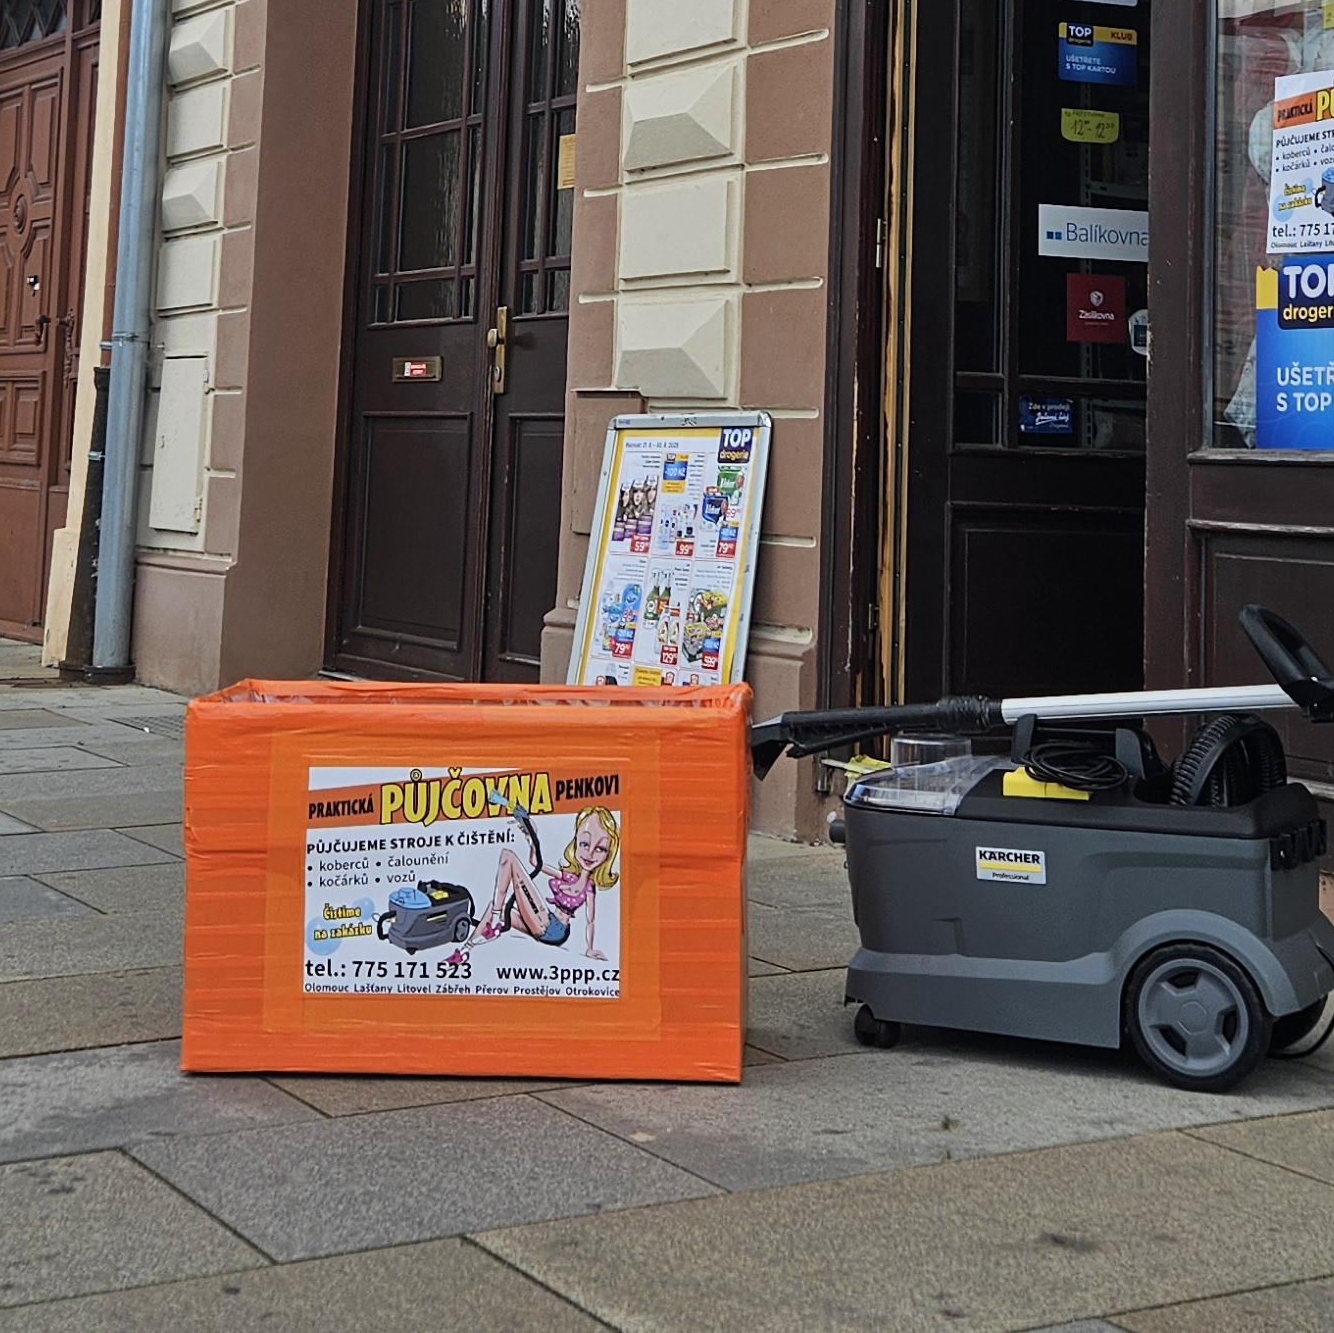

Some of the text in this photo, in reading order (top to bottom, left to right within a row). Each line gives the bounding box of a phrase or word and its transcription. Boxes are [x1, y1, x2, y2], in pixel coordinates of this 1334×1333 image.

[1068, 25, 1092, 37] TOP
[1275, 132, 1321, 148] PŮJČUJEME
[1066, 222, 1148, 247] Balíkovna
[1272, 223, 1296, 238] tel.:
[1299, 223, 1321, 237] 775
[1276, 392, 1288, 412] S
[1293, 392, 1332, 412] TOP
[722, 428, 751, 447] TOP
[719, 449, 749, 461] drogerie
[308, 767, 620, 827] PRAKTICKÁ PŮJČOVNA PENKOVI
[306, 828, 515, 854] PŮJČUJEME STROJE K ČIŠTĚNÍ:
[319, 852, 449, 872] koberců čalounění
[319, 869, 416, 887] kočárků vozů
[323, 902, 362, 920] Čistíme
[313, 927, 330, 941] na
[305, 959, 621, 985] tel.: 775 171 523 www.3ppp.cz
[304, 983, 621, 998] Olomouc Lašťany Litovel Zábřeh Přerov Prostějov Otrokovice
